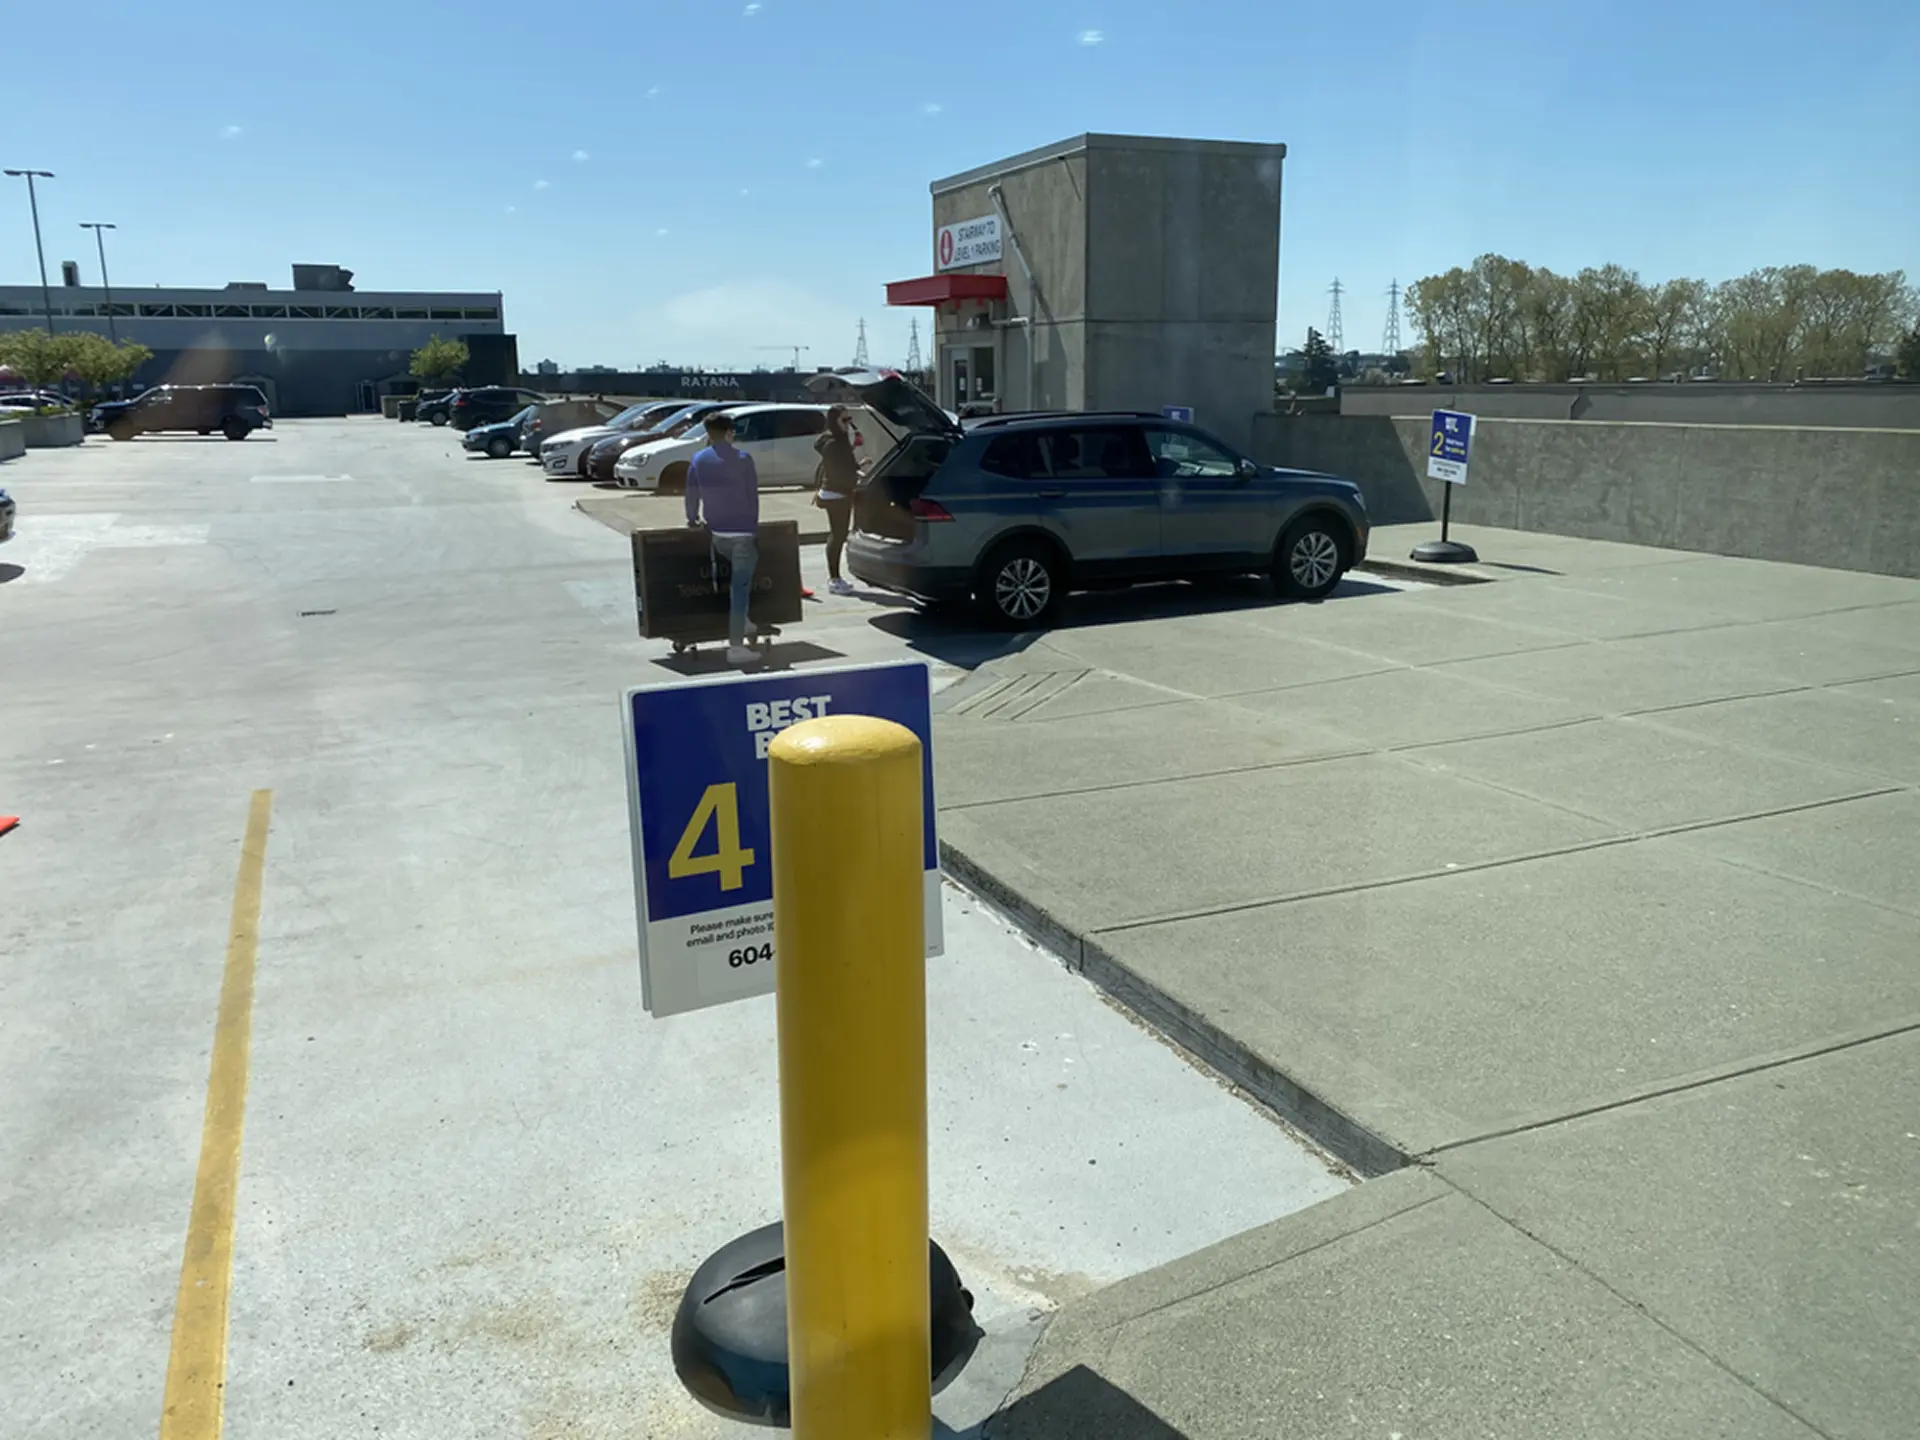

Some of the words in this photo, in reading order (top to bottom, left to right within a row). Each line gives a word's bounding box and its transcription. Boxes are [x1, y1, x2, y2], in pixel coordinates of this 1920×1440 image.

[680, 375, 740, 387] RATANA
[1432, 431, 1444, 455] 2
[745, 695, 832, 732] BEST
[668, 782, 755, 891] 4
[686, 933, 714, 947] email
[716, 929, 735, 942] and
[736, 924, 766, 939] photo
[690, 921, 724, 935] Please
[725, 916, 752, 928] make
